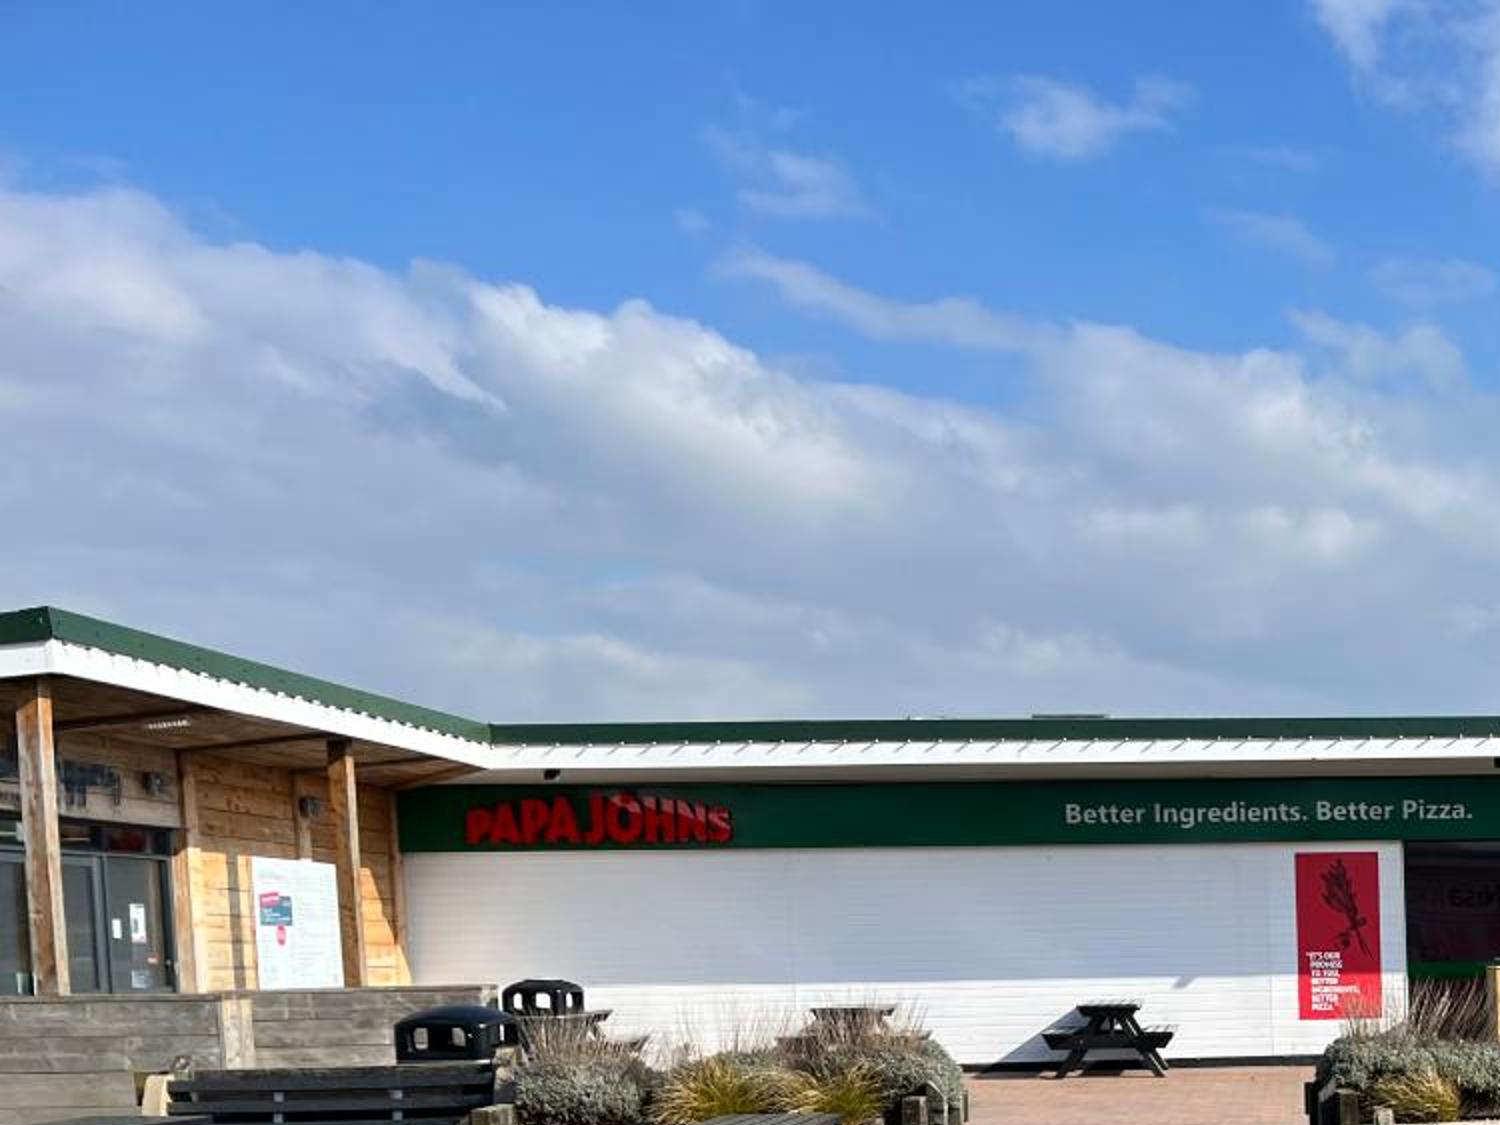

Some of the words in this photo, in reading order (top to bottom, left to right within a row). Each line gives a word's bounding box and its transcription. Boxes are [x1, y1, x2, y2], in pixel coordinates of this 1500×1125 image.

[465, 798, 578, 845] PAPA
[582, 790, 733, 845] JOHNS
[1065, 803, 1146, 824] Better
[1155, 801, 1308, 829] Ingredients.
[1316, 800, 1394, 821] Better
[1402, 799, 1473, 820] Pizza.
